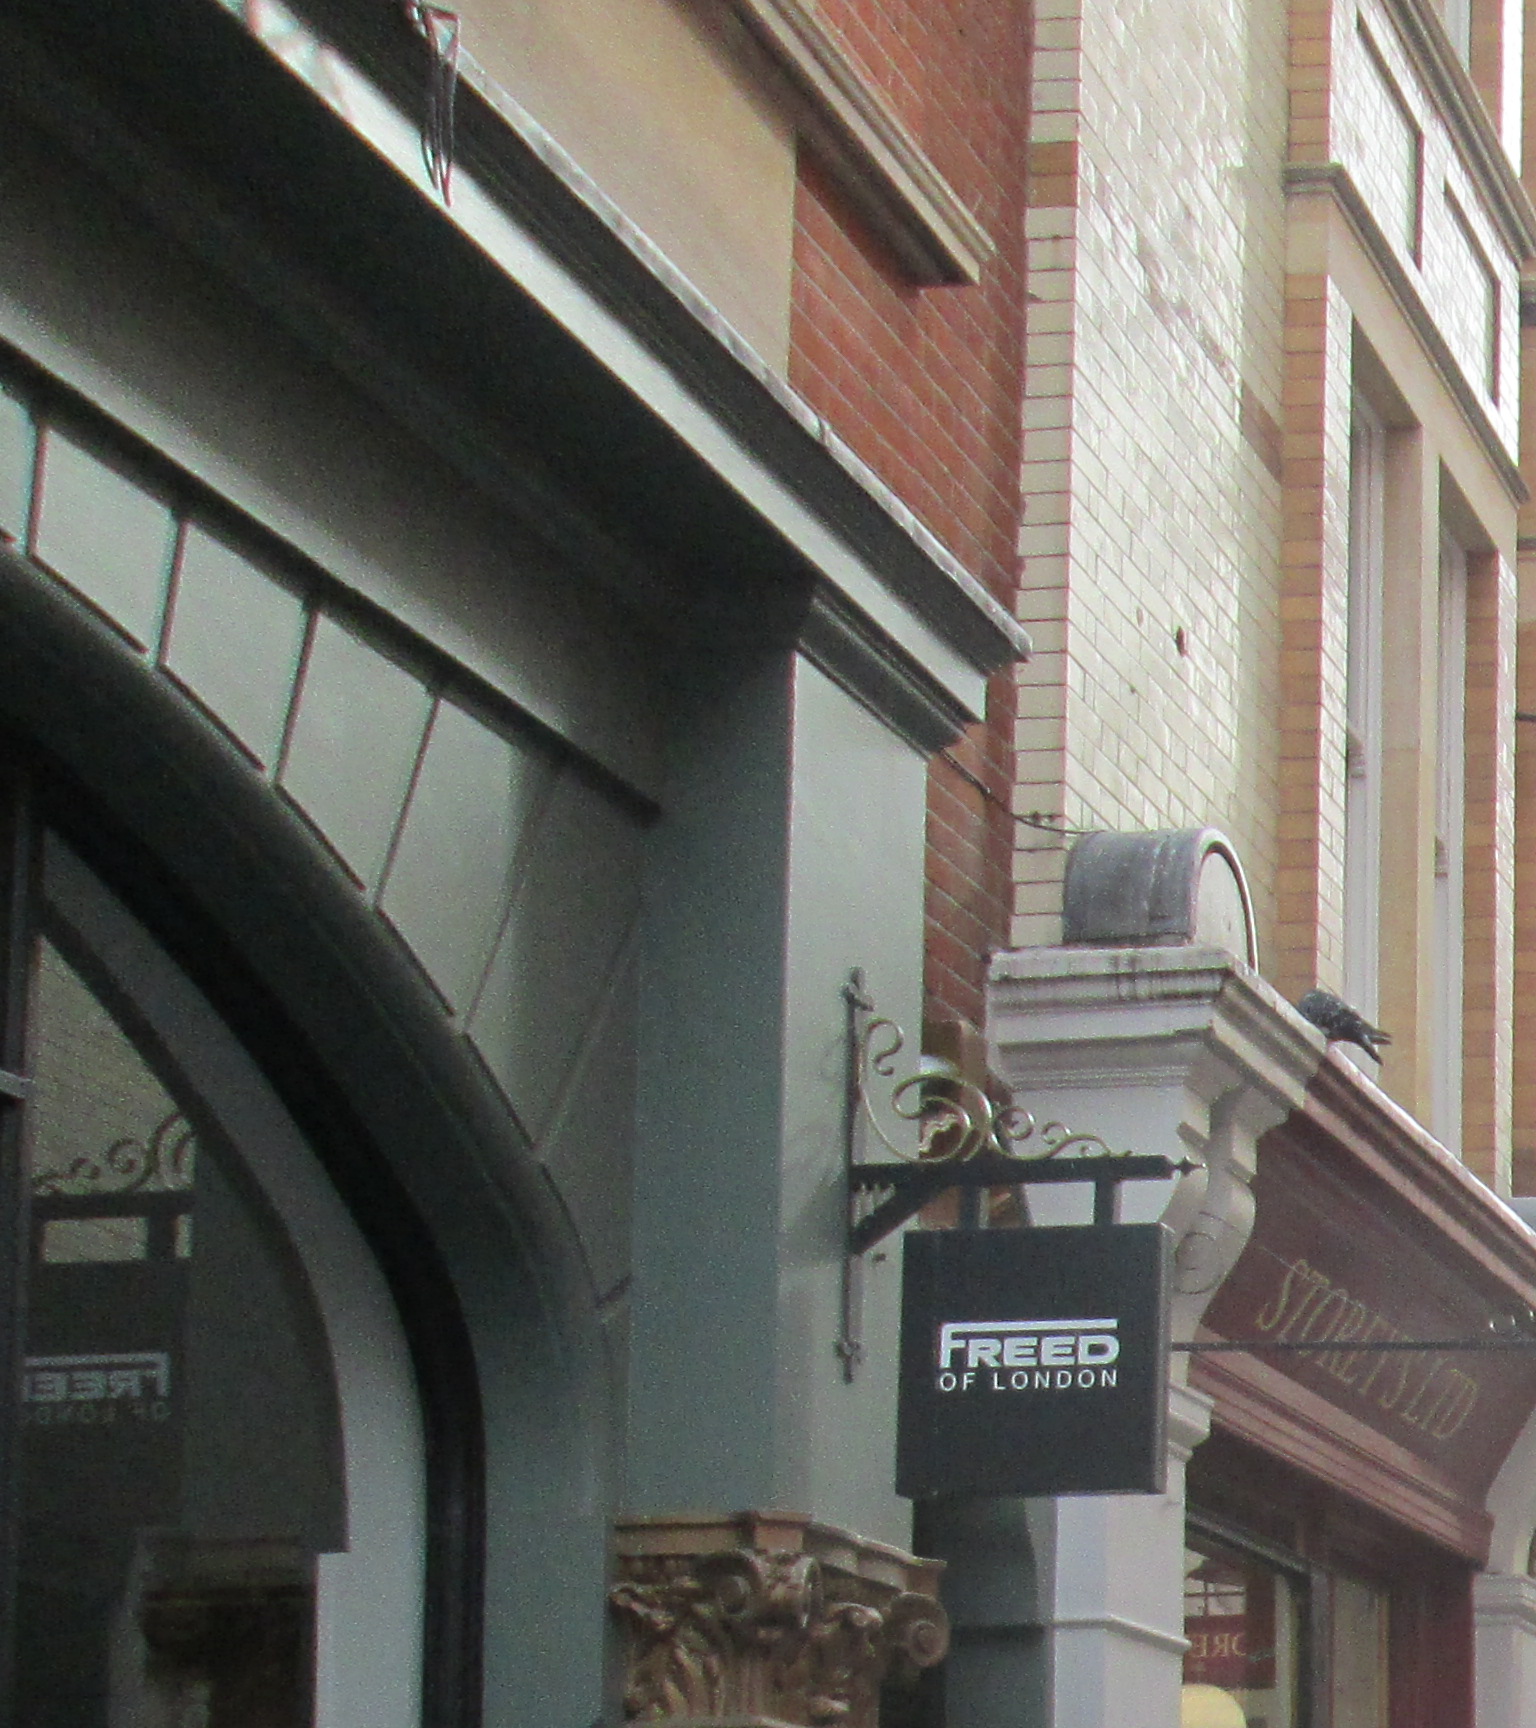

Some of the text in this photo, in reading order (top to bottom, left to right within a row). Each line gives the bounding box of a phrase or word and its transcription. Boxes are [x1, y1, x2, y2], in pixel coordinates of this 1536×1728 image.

[939, 1318, 1121, 1369] FREED
[939, 1367, 1119, 1393] OF LONDON
